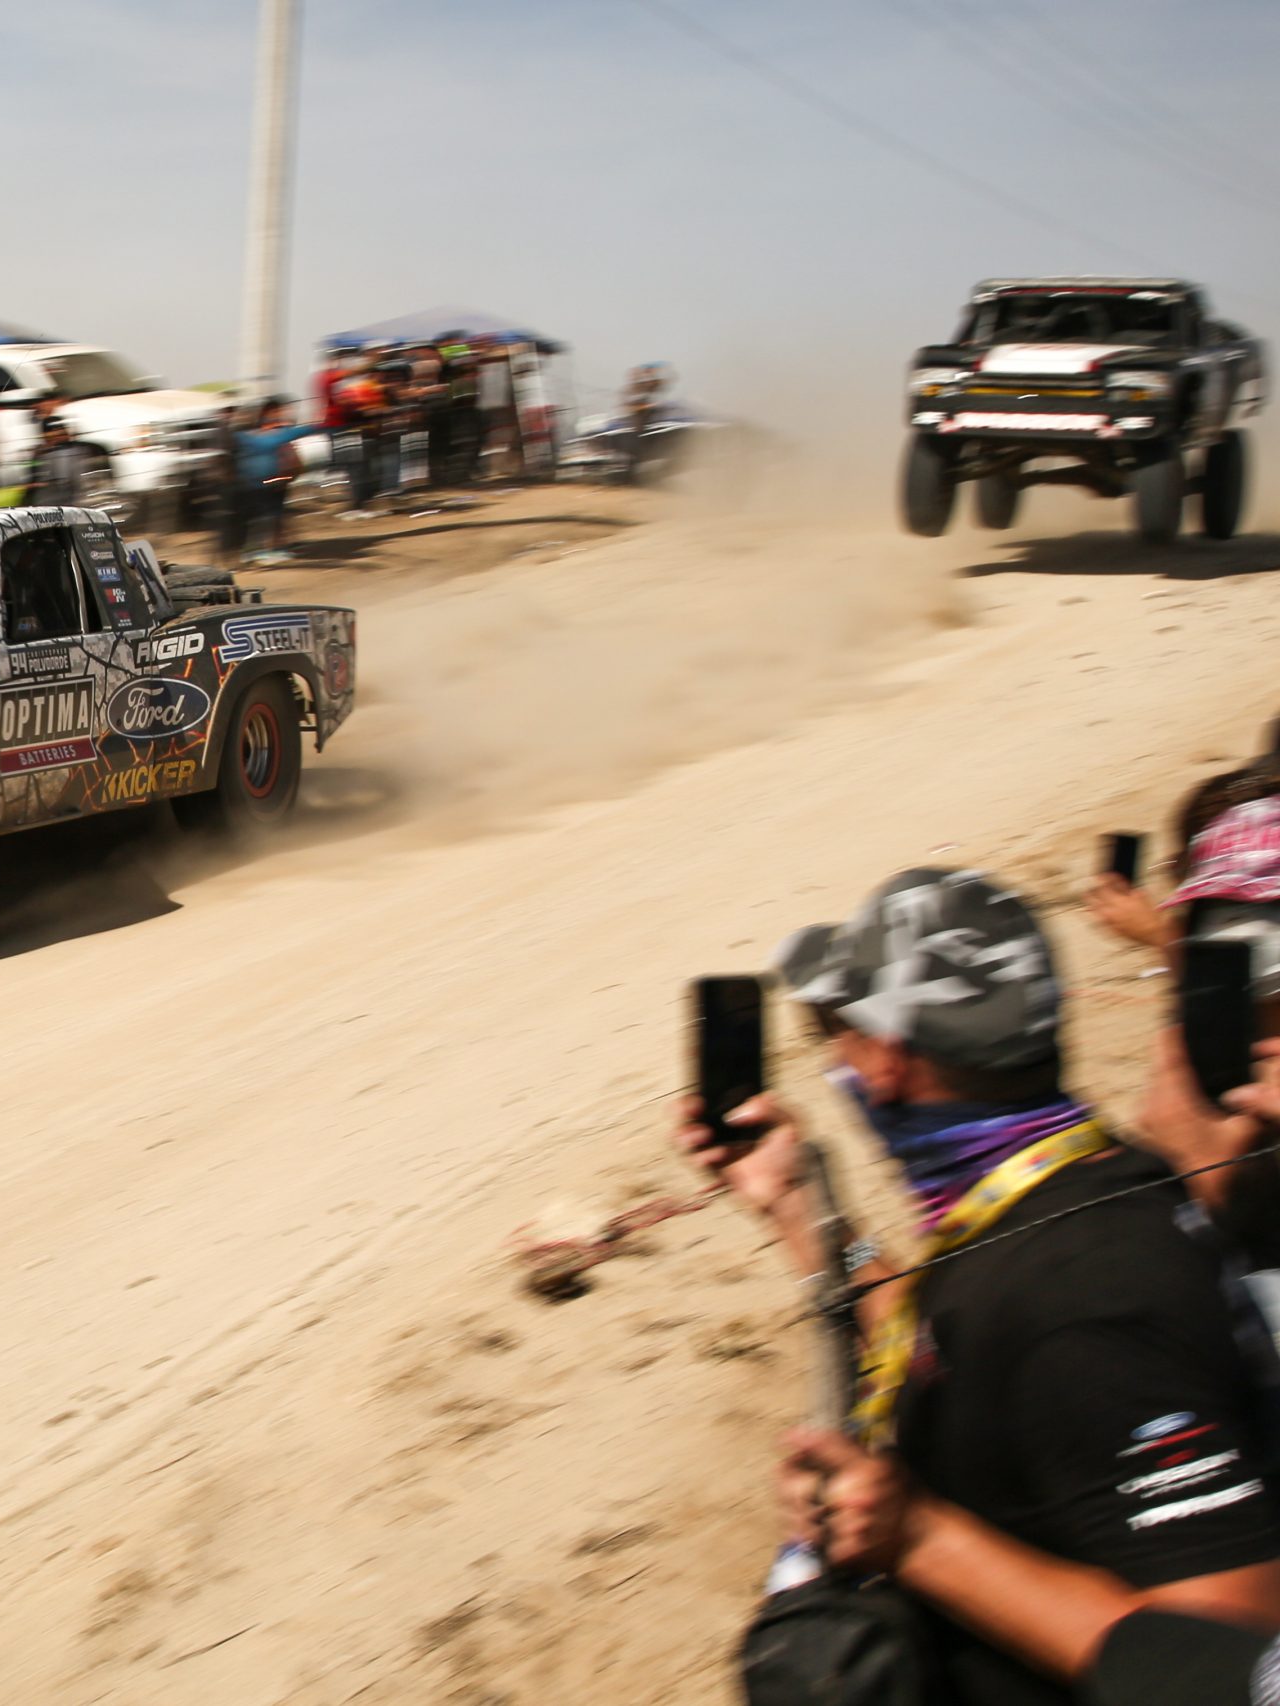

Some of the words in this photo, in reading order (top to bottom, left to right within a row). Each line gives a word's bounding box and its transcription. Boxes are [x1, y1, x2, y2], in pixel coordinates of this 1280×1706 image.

[10, 652, 28, 675] 94
[135, 632, 205, 664] RIGID
[2, 690, 88, 741] OPTIMA
[123, 687, 185, 730] Ford
[19, 745, 76, 766] BATTERIES
